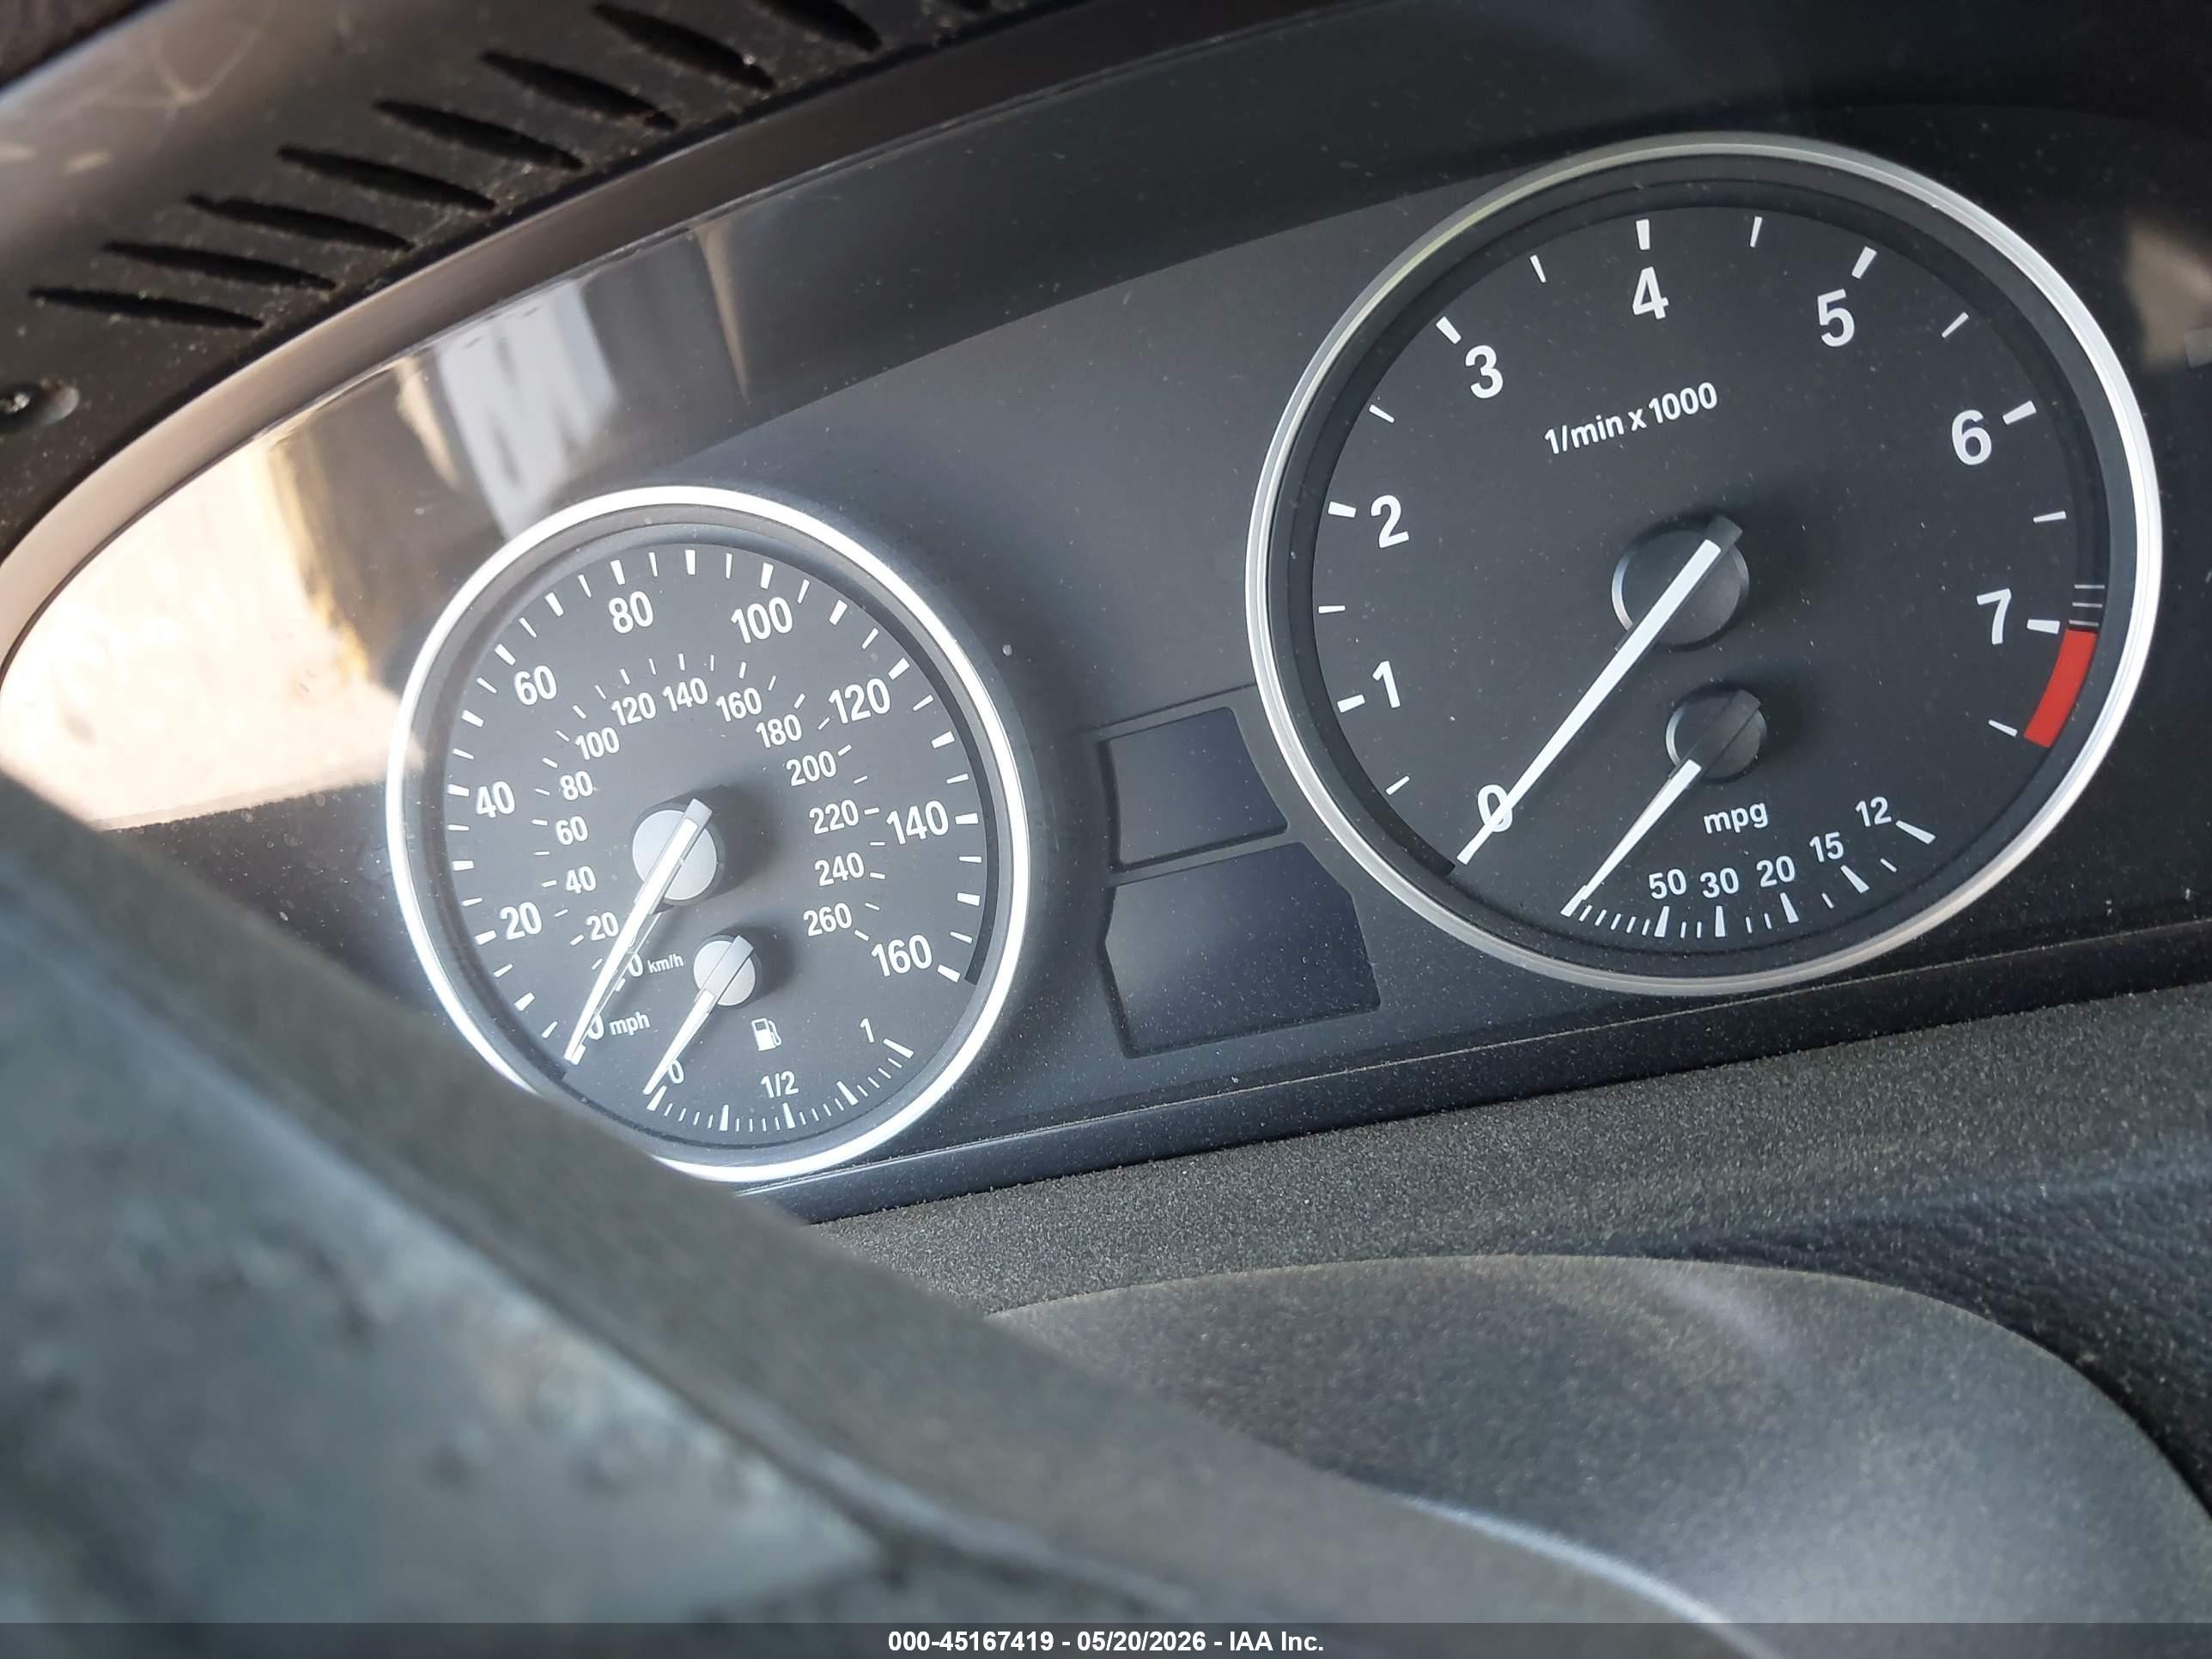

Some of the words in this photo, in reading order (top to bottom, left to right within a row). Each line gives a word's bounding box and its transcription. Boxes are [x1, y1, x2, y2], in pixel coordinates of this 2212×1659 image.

[1632, 266, 1668, 321] 4
[1816, 289, 1855, 347] 5
[1464, 345, 1504, 399] 3
[1545, 414, 1625, 453] 1/min
[1627, 407, 1647, 429] x
[1647, 381, 1717, 425] 1000
[1951, 409, 1992, 465] 6
[1370, 495, 1409, 548] 2
[609, 591, 654, 634] 80
[731, 597, 793, 643] 100
[1977, 588, 2011, 645] 7
[514, 665, 556, 705] 60
[662, 677, 708, 712] 140
[829, 678, 891, 725] 120
[1371, 661, 1401, 708] 1
[611, 692, 657, 725] 120
[715, 688, 763, 722] 160
[574, 726, 619, 759] 100
[755, 714, 802, 748] 180
[786, 750, 836, 786] 200
[476, 781, 515, 819] 40
[559, 771, 593, 800] 80
[809, 799, 860, 834] 220
[885, 801, 949, 845] 140
[1476, 784, 1513, 832] 0
[1704, 800, 1768, 834] mpg
[1856, 796, 1893, 827] 12
[555, 817, 587, 845] 60
[1809, 832, 1844, 862] 15
[564, 866, 596, 893] 40
[815, 854, 864, 886] 240
[1648, 869, 1687, 900] 50
[1701, 867, 1740, 898] 30
[1757, 856, 1796, 888] 20
[499, 902, 542, 939] 20
[586, 912, 619, 940] 20
[804, 902, 853, 935] 260
[647, 954, 684, 975] km/h
[871, 934, 932, 977] 160
[610, 1012, 650, 1036] mph
[860, 1018, 873, 1042] 1
[667, 1060, 684, 1085] 0
[761, 1072, 799, 1098] 1/2
